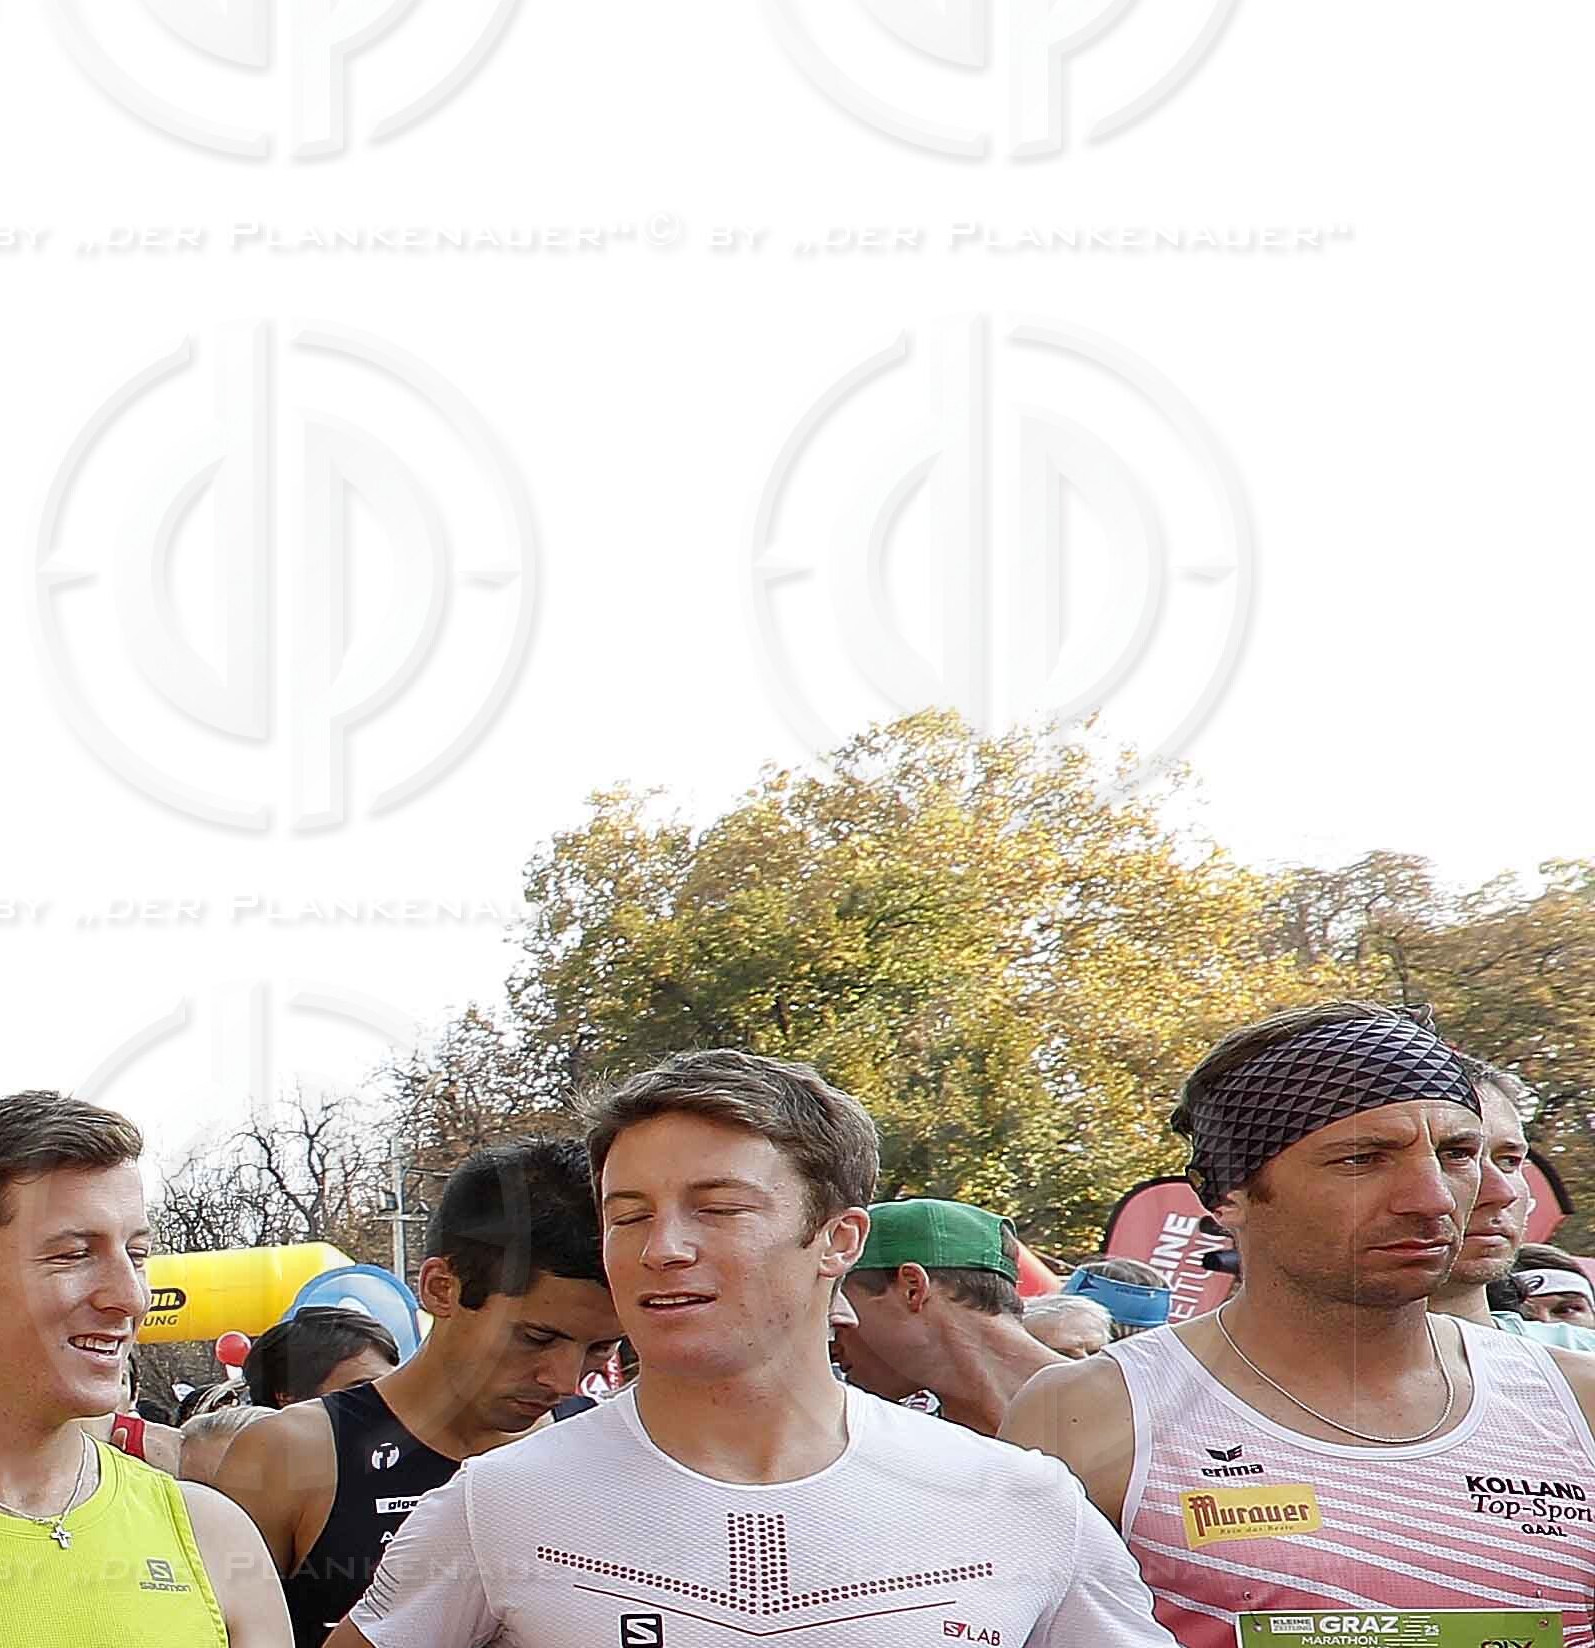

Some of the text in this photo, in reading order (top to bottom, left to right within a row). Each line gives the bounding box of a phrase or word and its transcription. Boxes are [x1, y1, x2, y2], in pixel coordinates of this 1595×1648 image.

[1201, 1462, 1264, 1478] erima
[1465, 1475, 1587, 1501] KOLLAND
[1188, 1494, 1310, 1538] Murauer
[1521, 1523, 1568, 1537] GAAL
[1272, 1618, 1311, 1626] KLEINE
[1320, 1616, 1399, 1633] GRAZ
[1301, 1635, 1379, 1645] MARATHON
